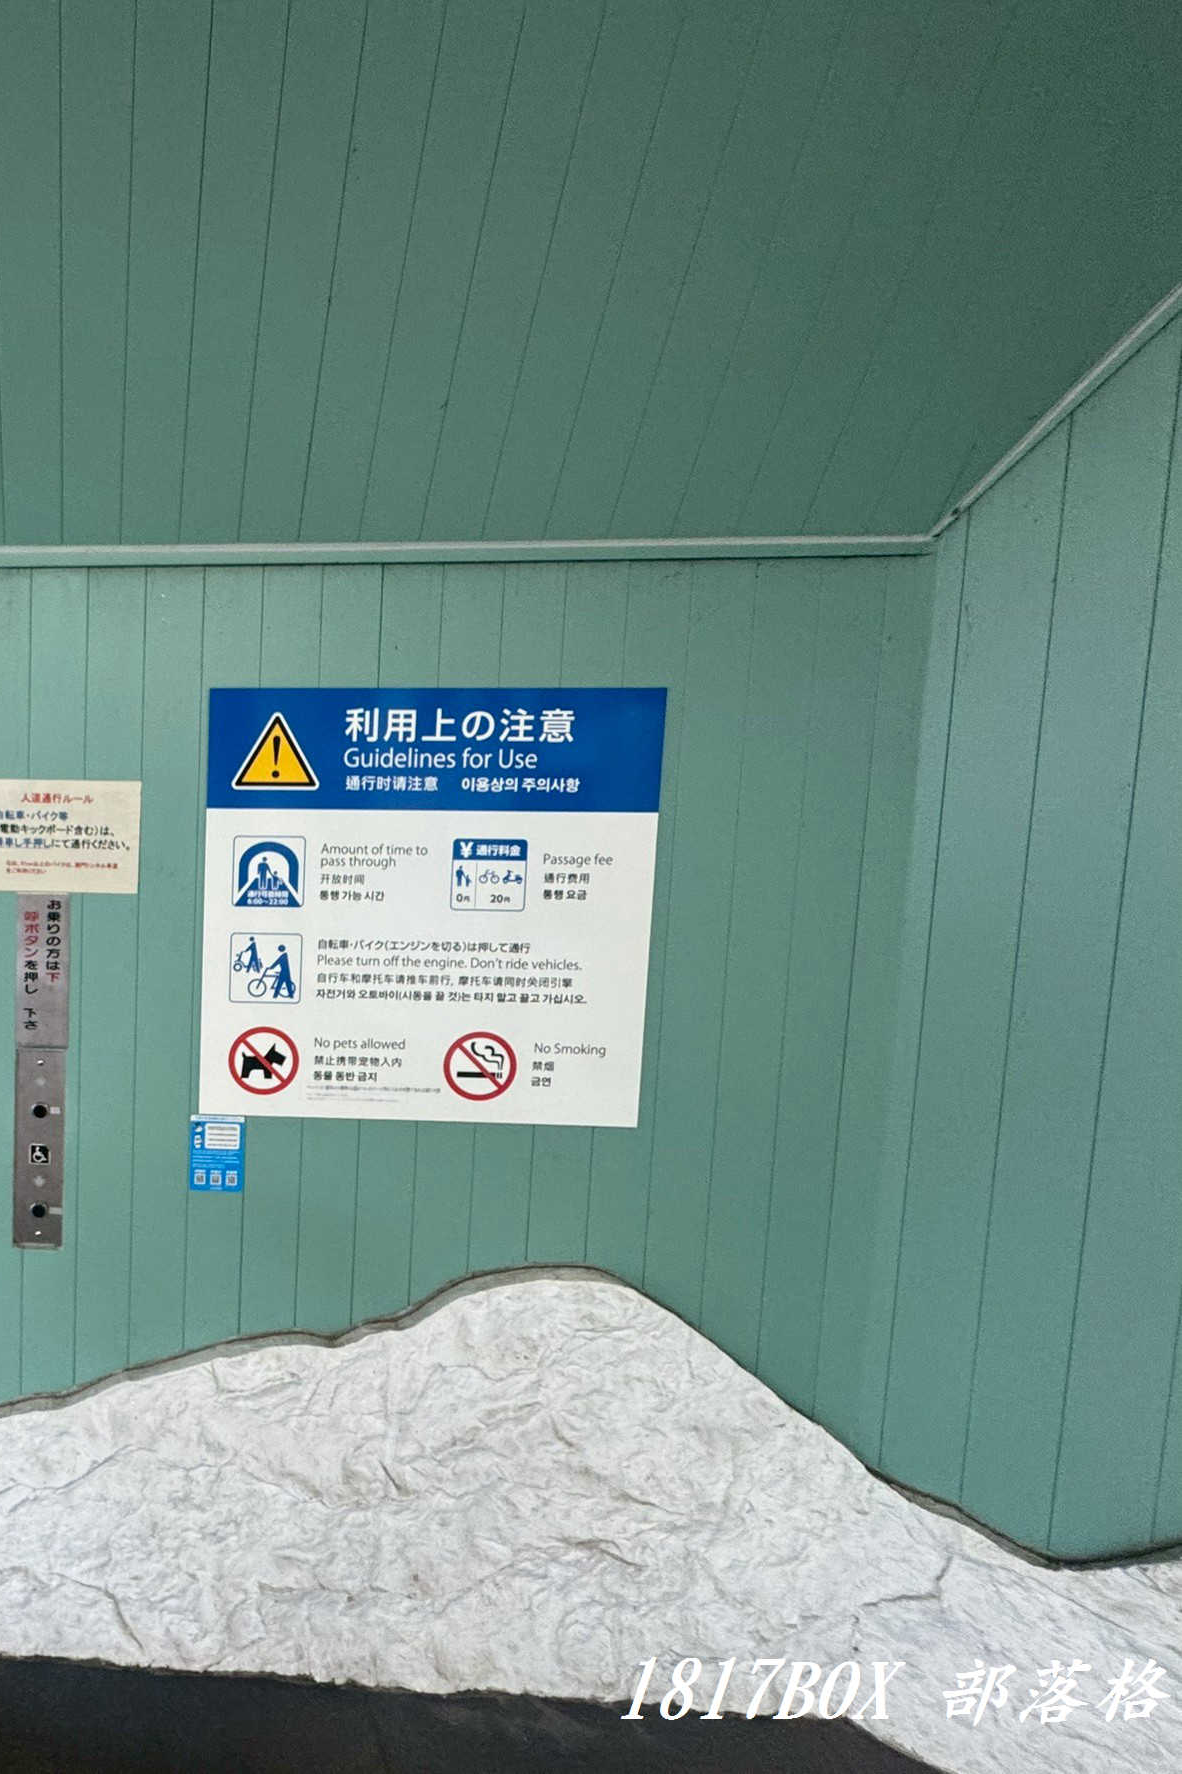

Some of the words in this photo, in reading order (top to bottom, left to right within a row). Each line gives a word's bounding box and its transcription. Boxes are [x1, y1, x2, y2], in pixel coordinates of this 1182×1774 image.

[344, 707, 575, 743] 利用上の注意
[344, 747, 456, 769] Guidelines
[462, 747, 493, 769] for
[498, 749, 538, 769] Use
[345, 775, 439, 792] 通行时请注意
[461, 777, 518, 793] 이용상의
[521, 778, 580, 793] 주의사항
[321, 843, 368, 856] Amount
[371, 844, 384, 855] of
[385, 844, 413, 856] time
[416, 845, 428, 856] to
[320, 857, 346, 868] pass
[349, 856, 396, 870] through
[543, 853, 591, 868] Passage
[594, 854, 613, 866] fee
[364, 890, 385, 902] 시간
[317, 954, 353, 966] Please
[356, 956, 380, 967] turn
[383, 955, 400, 967] off
[402, 956, 421, 967] the
[424, 957, 467, 971] engine.
[506, 958, 528, 970] ride
[532, 959, 582, 971] vehicles.
[314, 1037, 330, 1048] No
[333, 1038, 358, 1050] pets
[361, 1038, 406, 1050] allowed
[534, 1043, 551, 1054] No
[554, 1043, 606, 1058] Smoking
